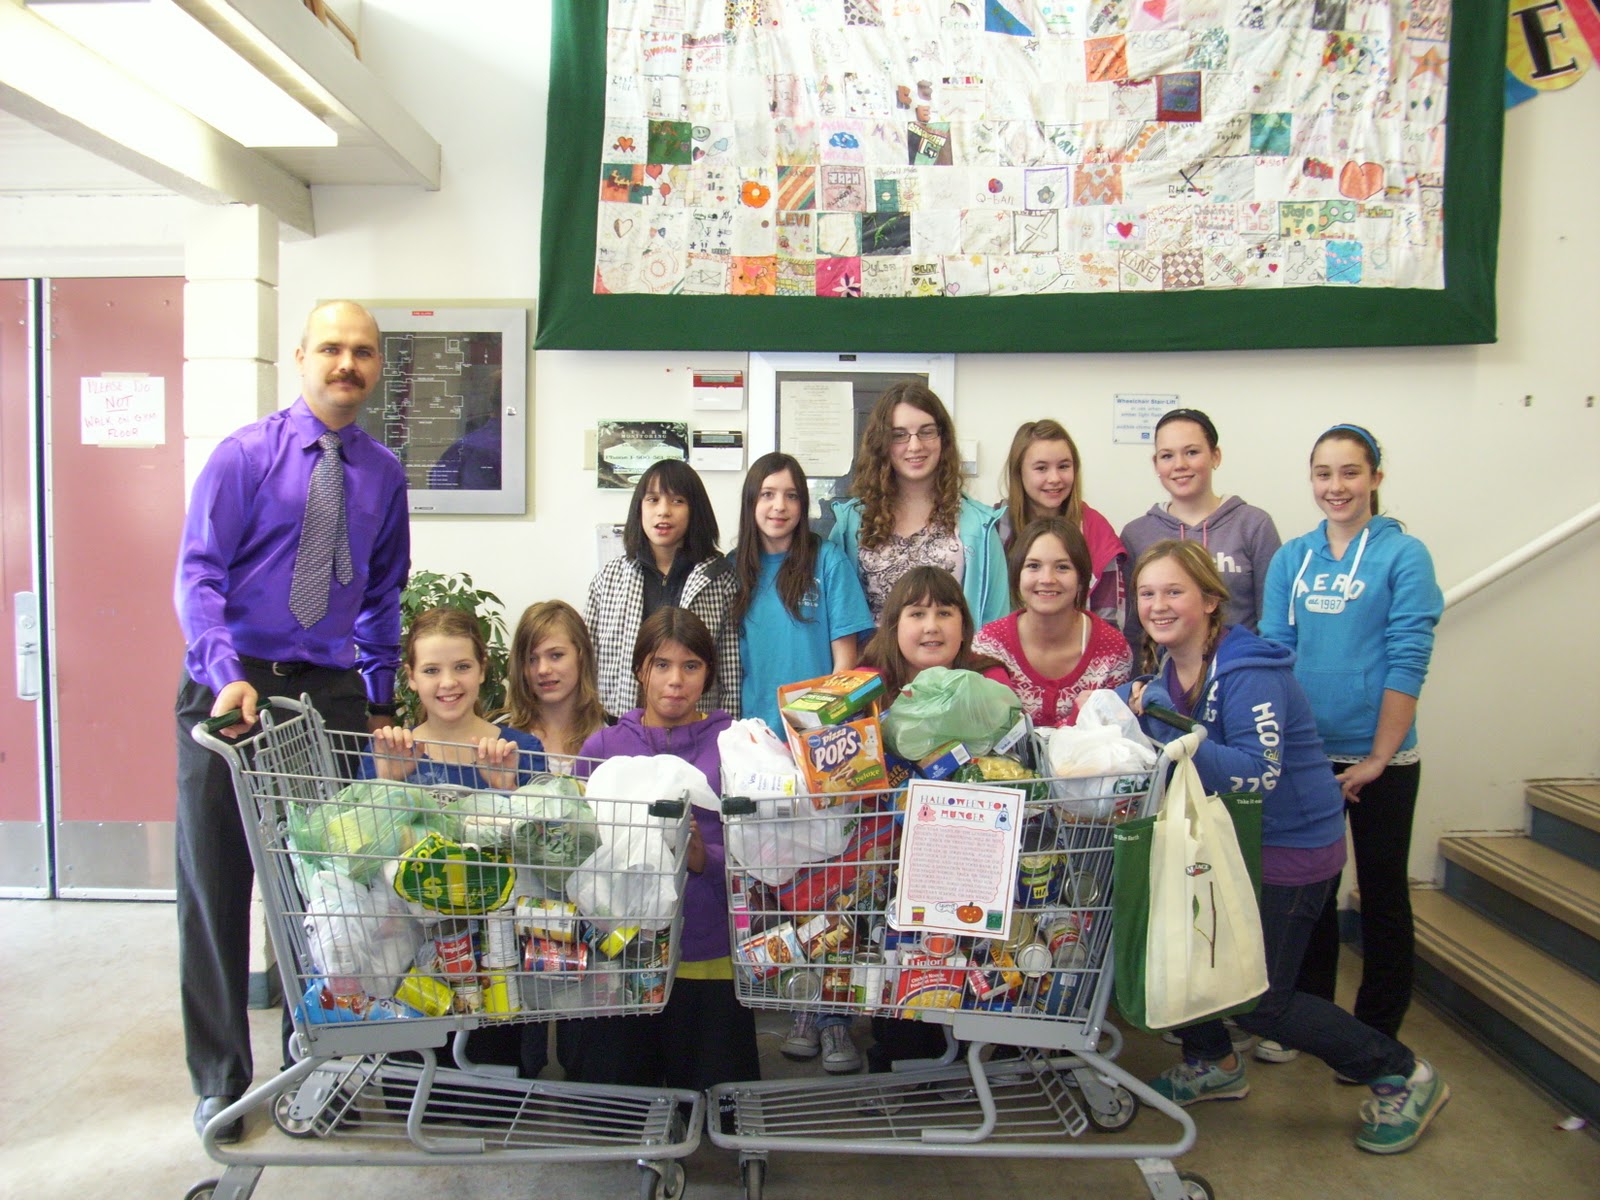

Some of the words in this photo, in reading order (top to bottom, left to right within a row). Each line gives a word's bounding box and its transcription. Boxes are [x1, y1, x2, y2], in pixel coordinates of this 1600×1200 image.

[1511, 0, 1577, 78] E
[776, 212, 810, 227] LEVI
[86, 379, 123, 394] PLEASE
[134, 379, 151, 392] DO
[105, 395, 134, 409] NOT
[84, 416, 113, 428] WALK
[108, 428, 139, 438] FLOOR
[1297, 573, 1366, 600] AERO
[1320, 600, 1342, 610] 1987
[1252, 702, 1281, 748] HCO
[821, 727, 847, 746] pizza
[814, 730, 858, 773] POPS
[920, 795, 984, 809] HALLOWEEN
[988, 801, 1008, 812] FOR
[828, 954, 847, 964] Garden
[911, 957, 943, 969] Lipton
